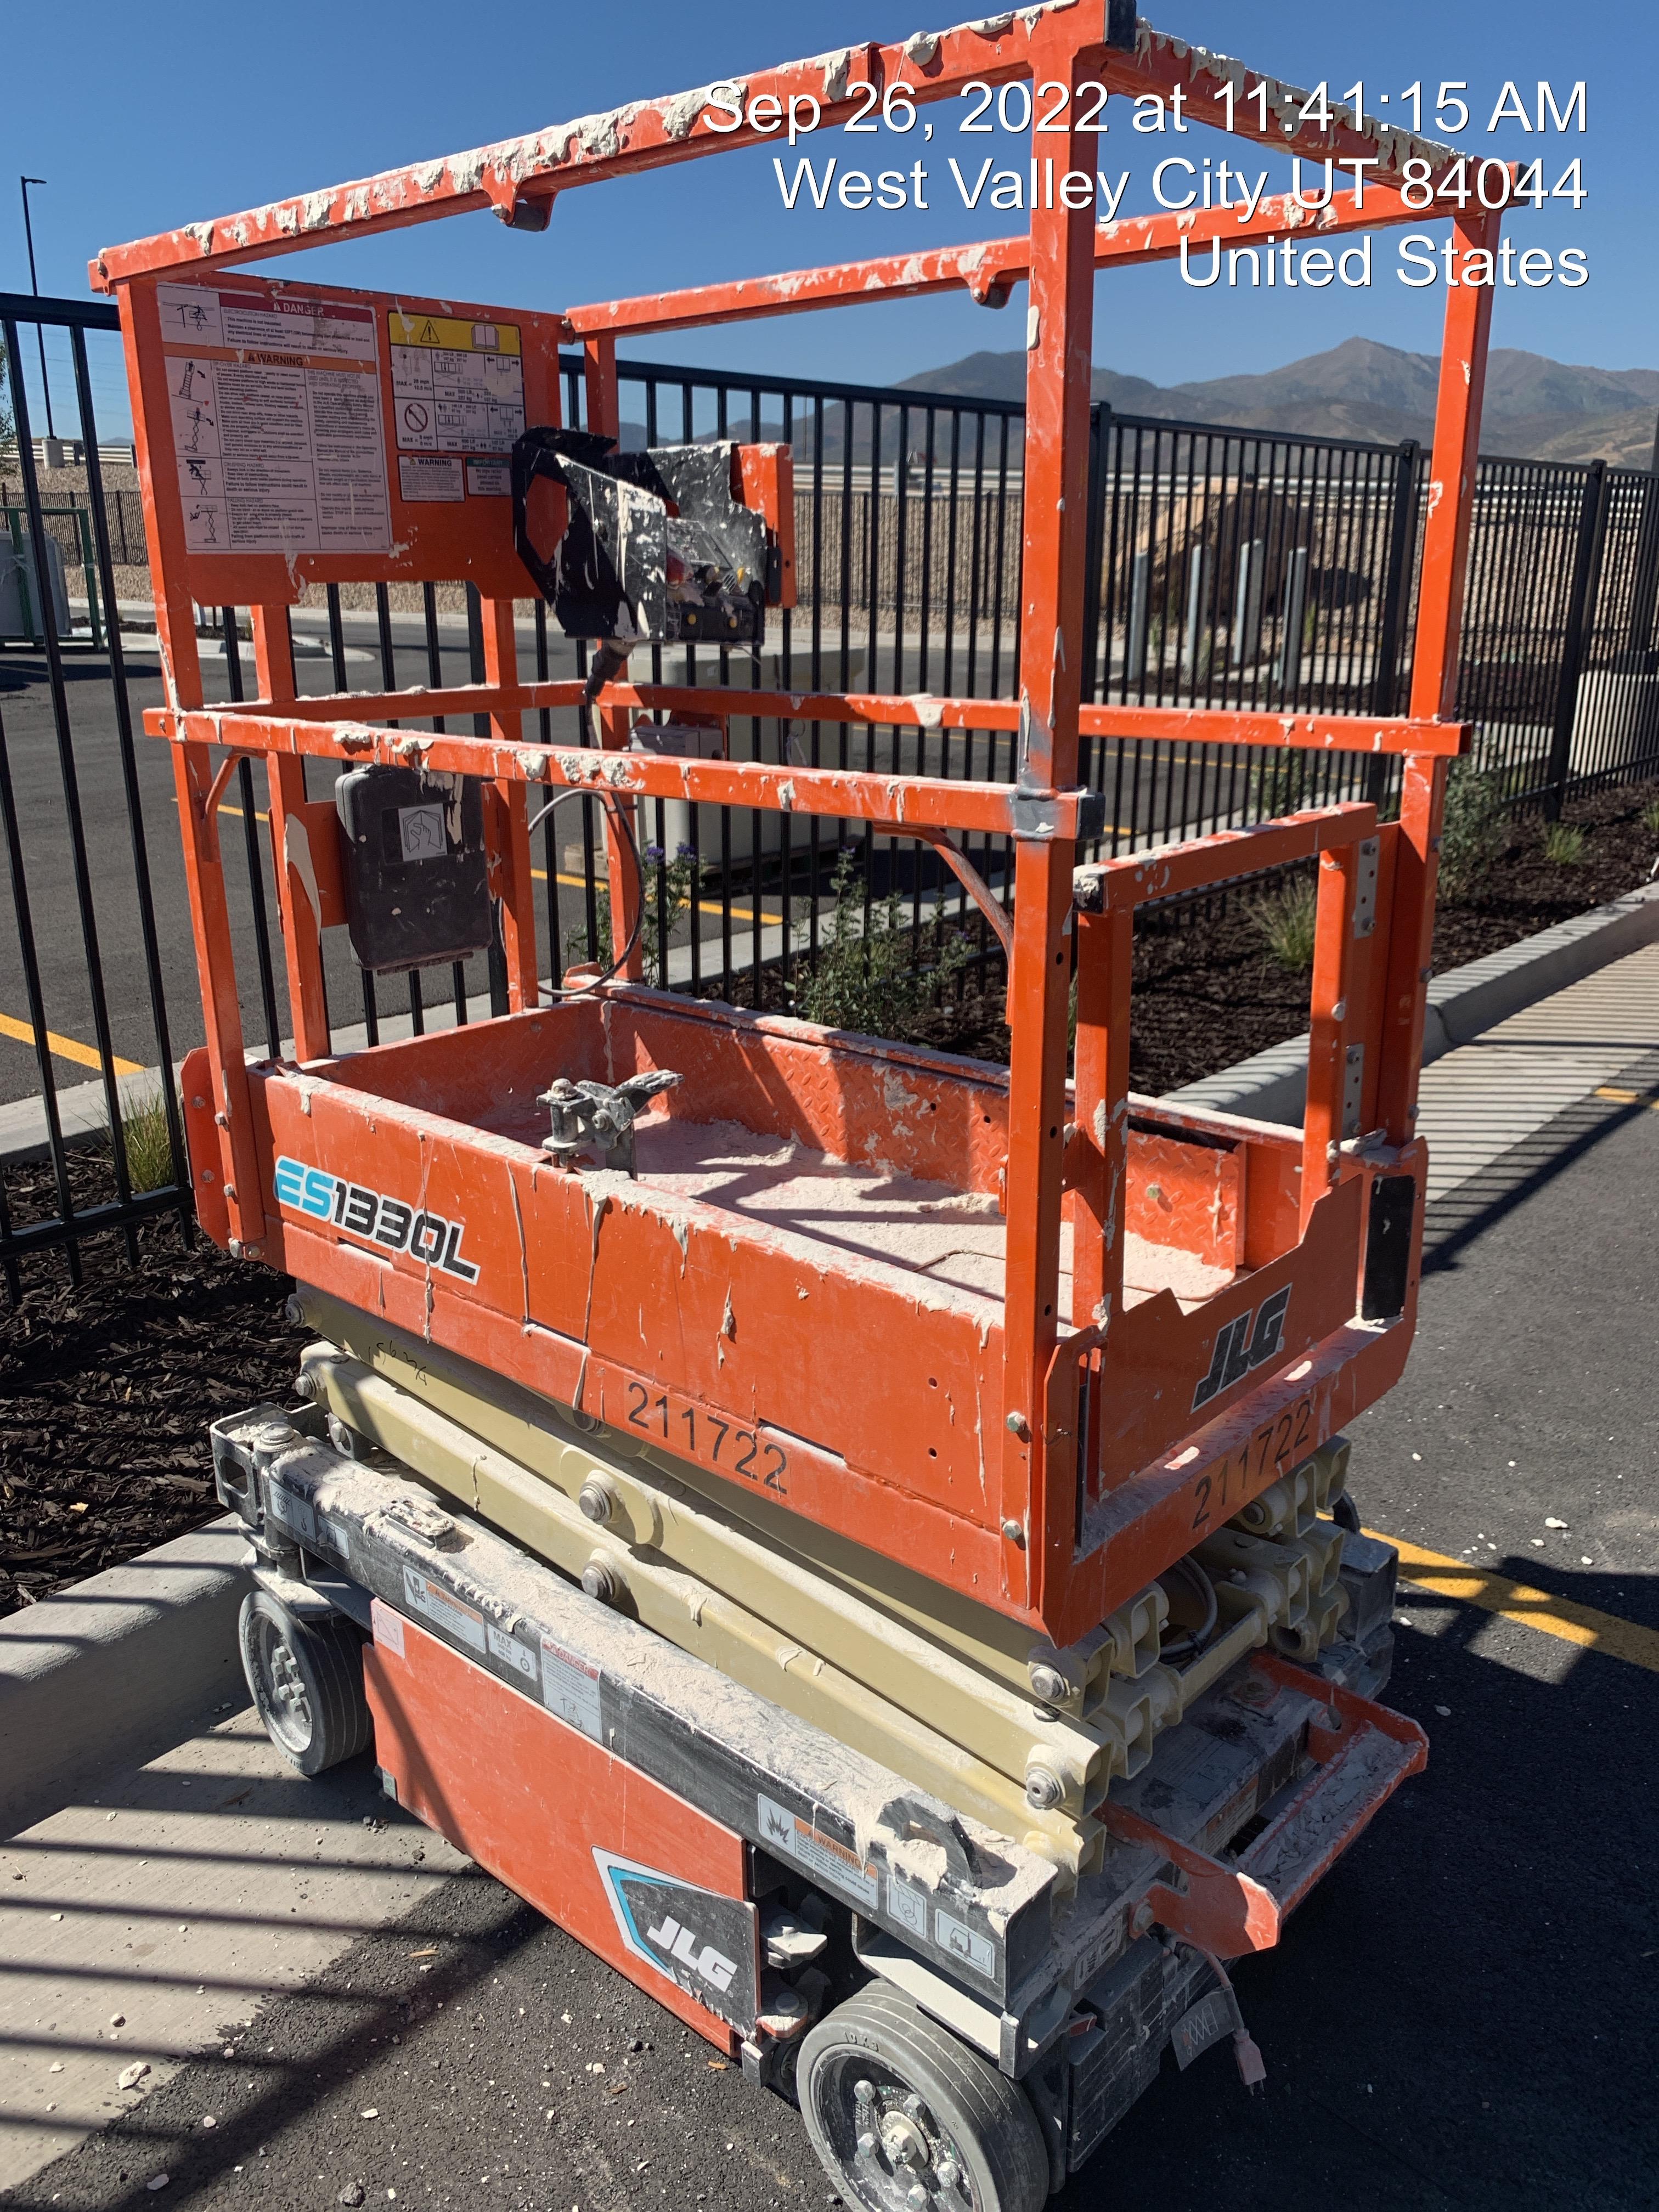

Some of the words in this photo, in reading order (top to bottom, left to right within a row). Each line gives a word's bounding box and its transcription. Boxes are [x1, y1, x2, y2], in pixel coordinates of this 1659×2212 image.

[283, 302, 325, 317] DANGER
[257, 353, 303, 366] WARNING
[417, 458, 452, 467] WARNING
[275, 1156, 479, 1284] ES1330L
[1190, 1282, 1294, 1414] JLG
[628, 1381, 788, 1495] 211722
[1192, 1398, 1313, 1531] 211722
[493, 1630, 512, 1650] MAX
[558, 1648, 589, 1674] DANGER
[818, 1835, 861, 1869] WARNING
[646, 1915, 738, 1993] JLG
